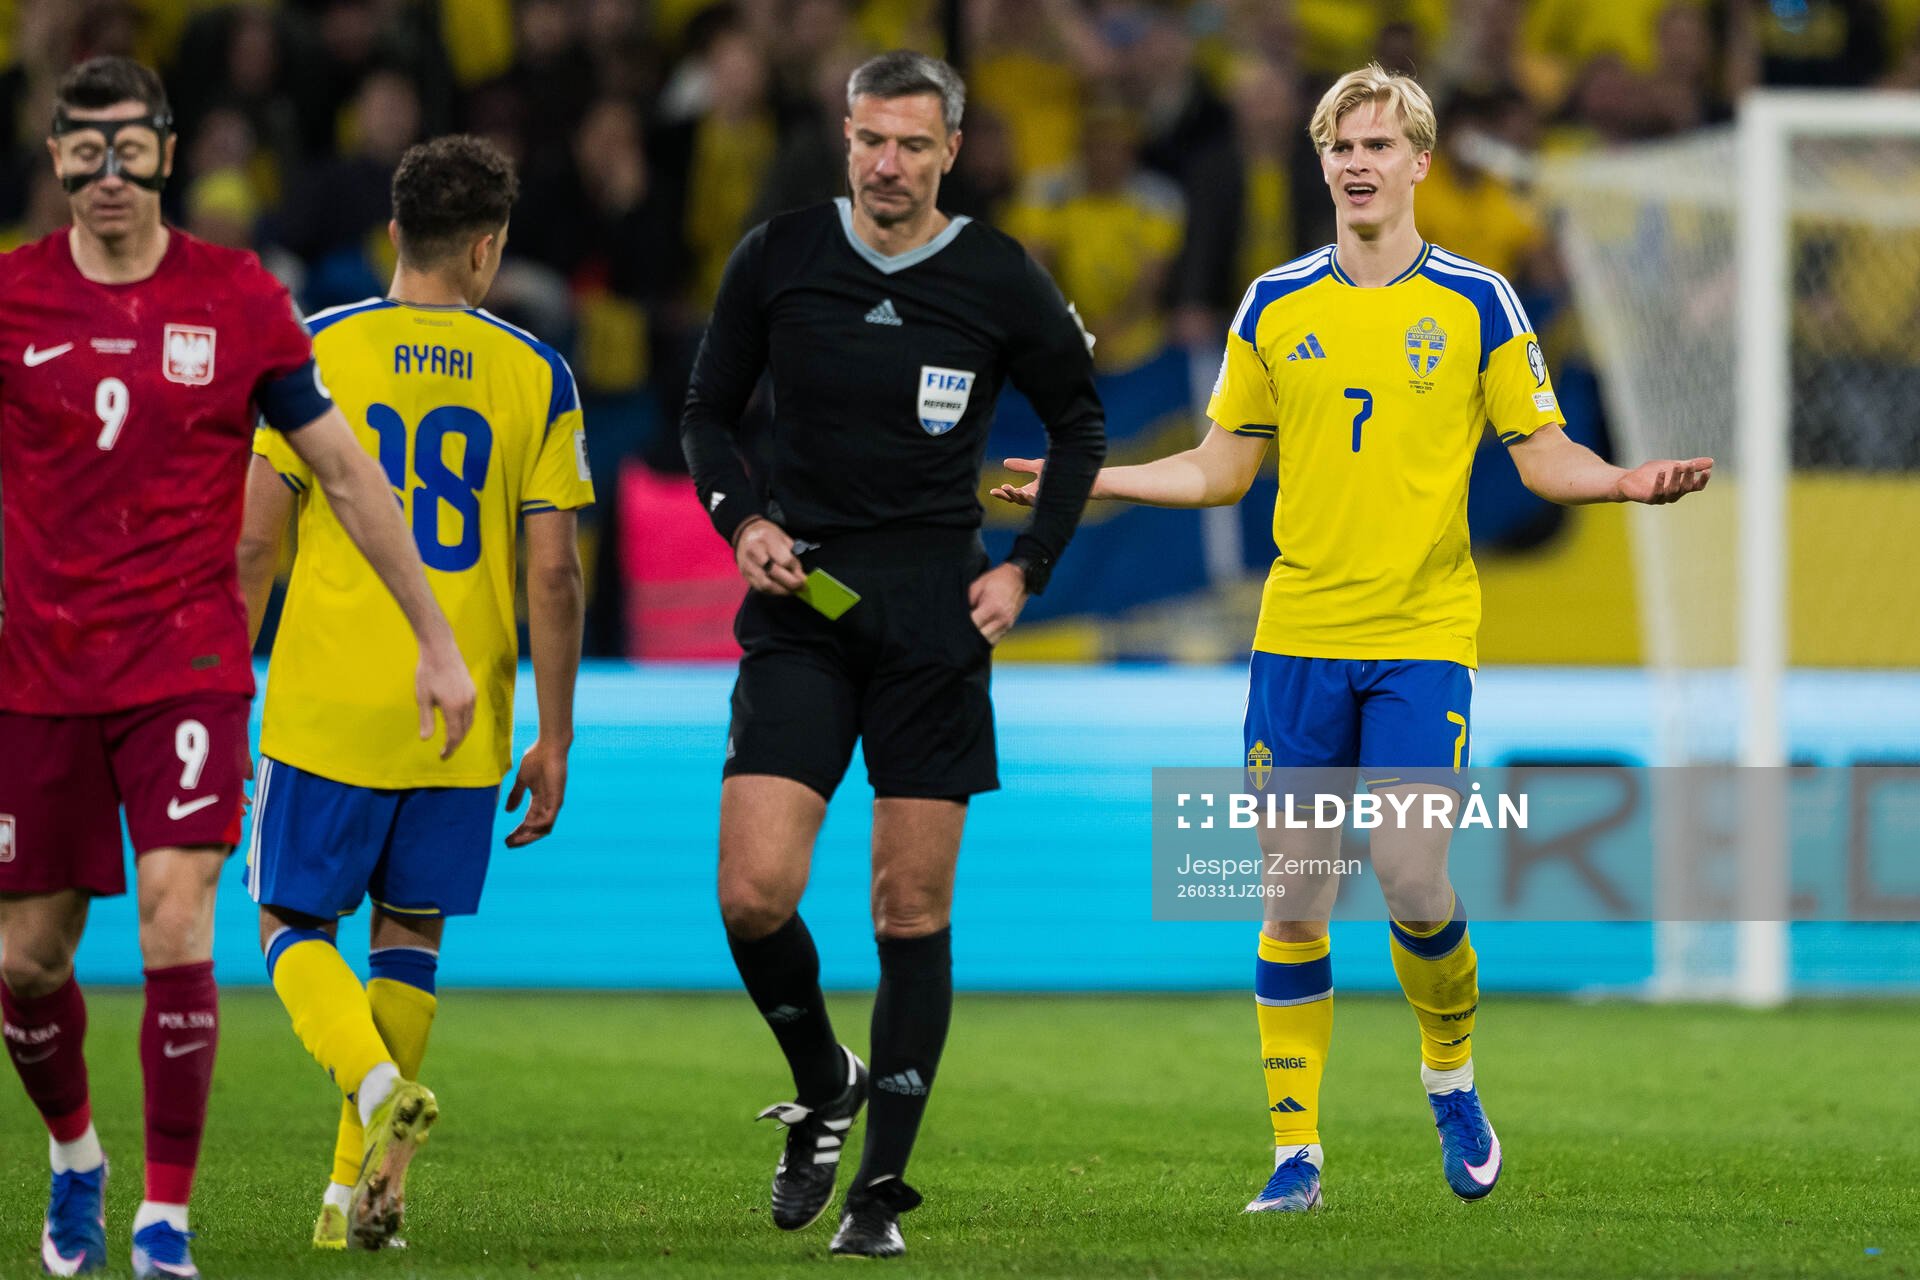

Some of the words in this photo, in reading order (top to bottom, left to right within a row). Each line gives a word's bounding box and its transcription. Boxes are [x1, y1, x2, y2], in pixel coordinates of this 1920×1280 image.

[395, 344, 473, 380] AYARI
[927, 373, 967, 391] FIFA
[95, 376, 130, 451] 9
[1343, 387, 1374, 453] 7
[366, 403, 493, 573] 18
[175, 719, 209, 790] 9
[1446, 710, 1467, 775] 7
[1263, 1056, 1307, 1070] VERIGE
